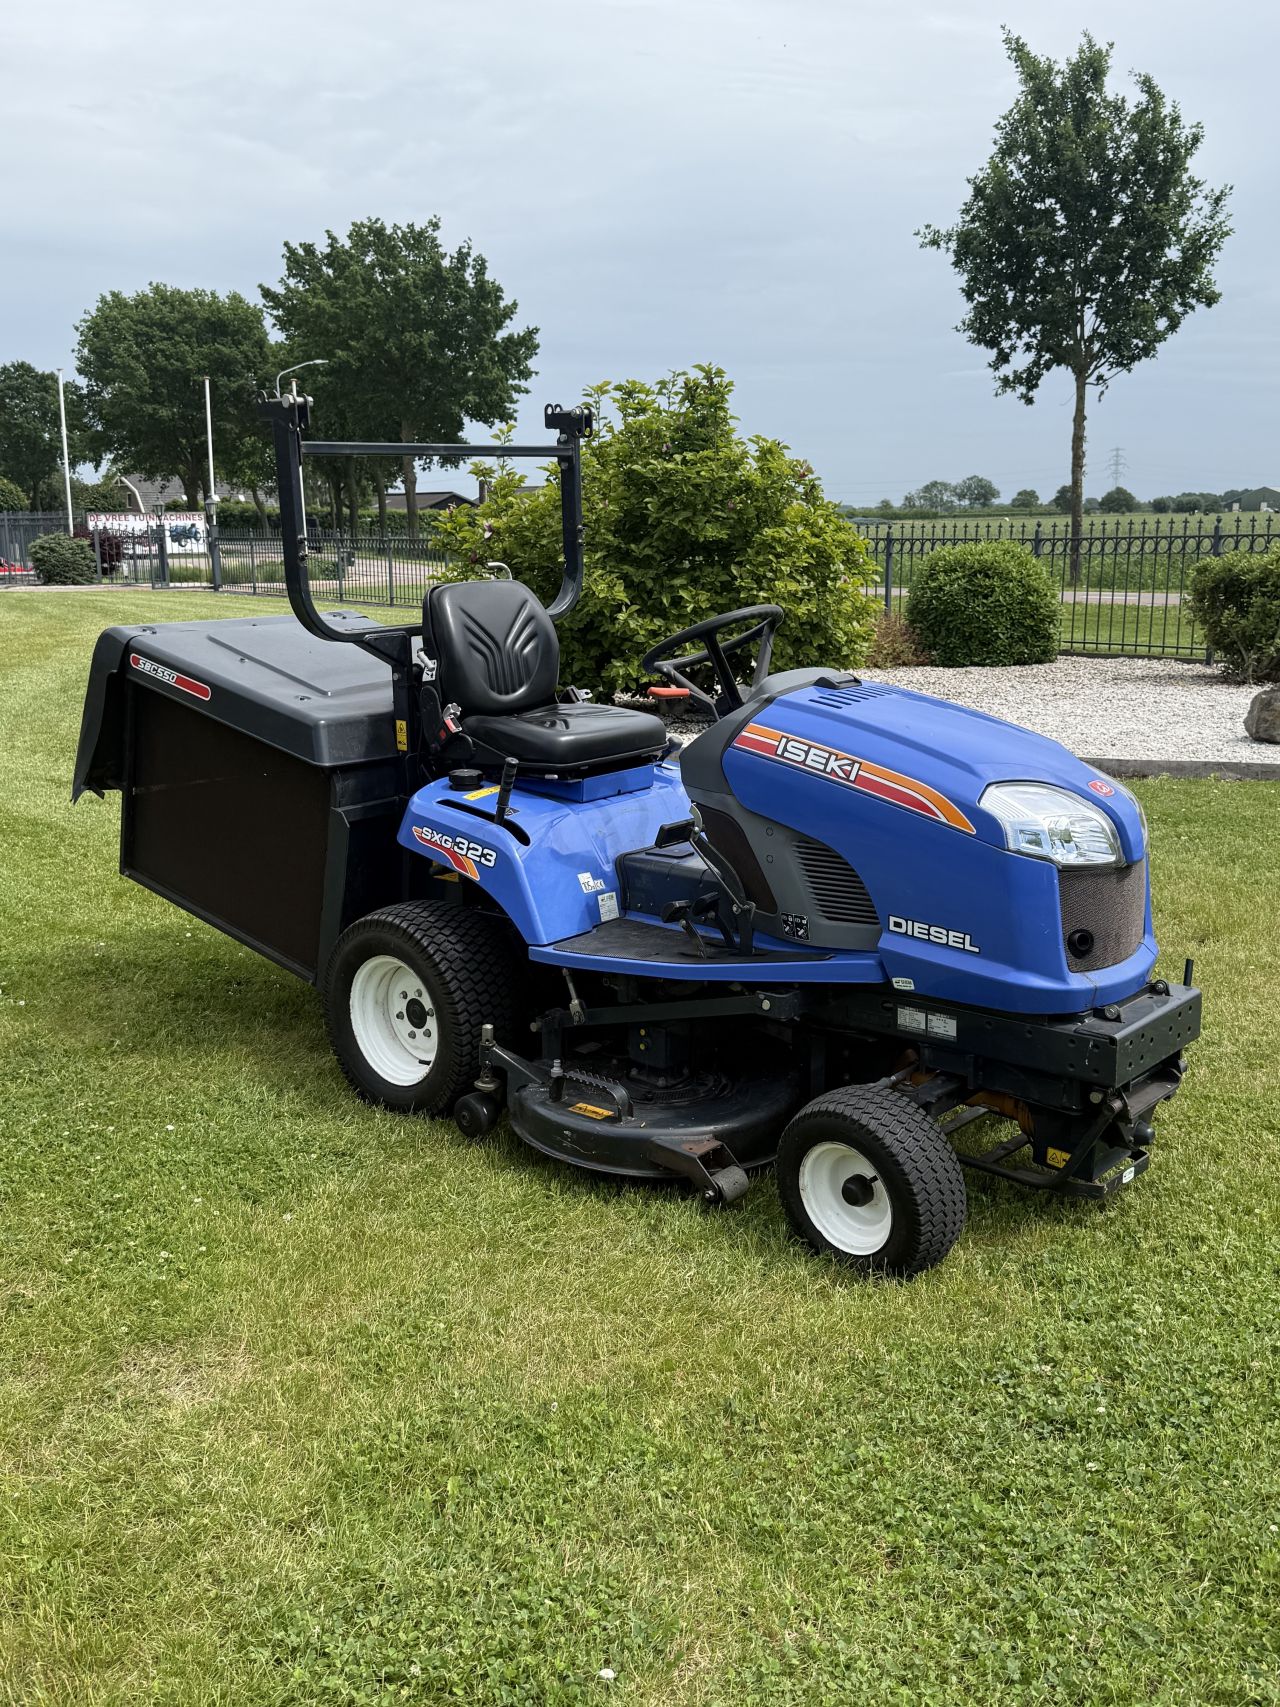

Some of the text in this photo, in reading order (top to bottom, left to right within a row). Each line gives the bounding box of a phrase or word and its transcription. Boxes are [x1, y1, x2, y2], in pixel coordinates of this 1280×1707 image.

[89, 514, 102, 522] DE
[104, 514, 130, 522] VREE
[138, 660, 177, 683] SBC550
[775, 736, 861, 782] ISEKI
[888, 915, 980, 953] DIESEL
